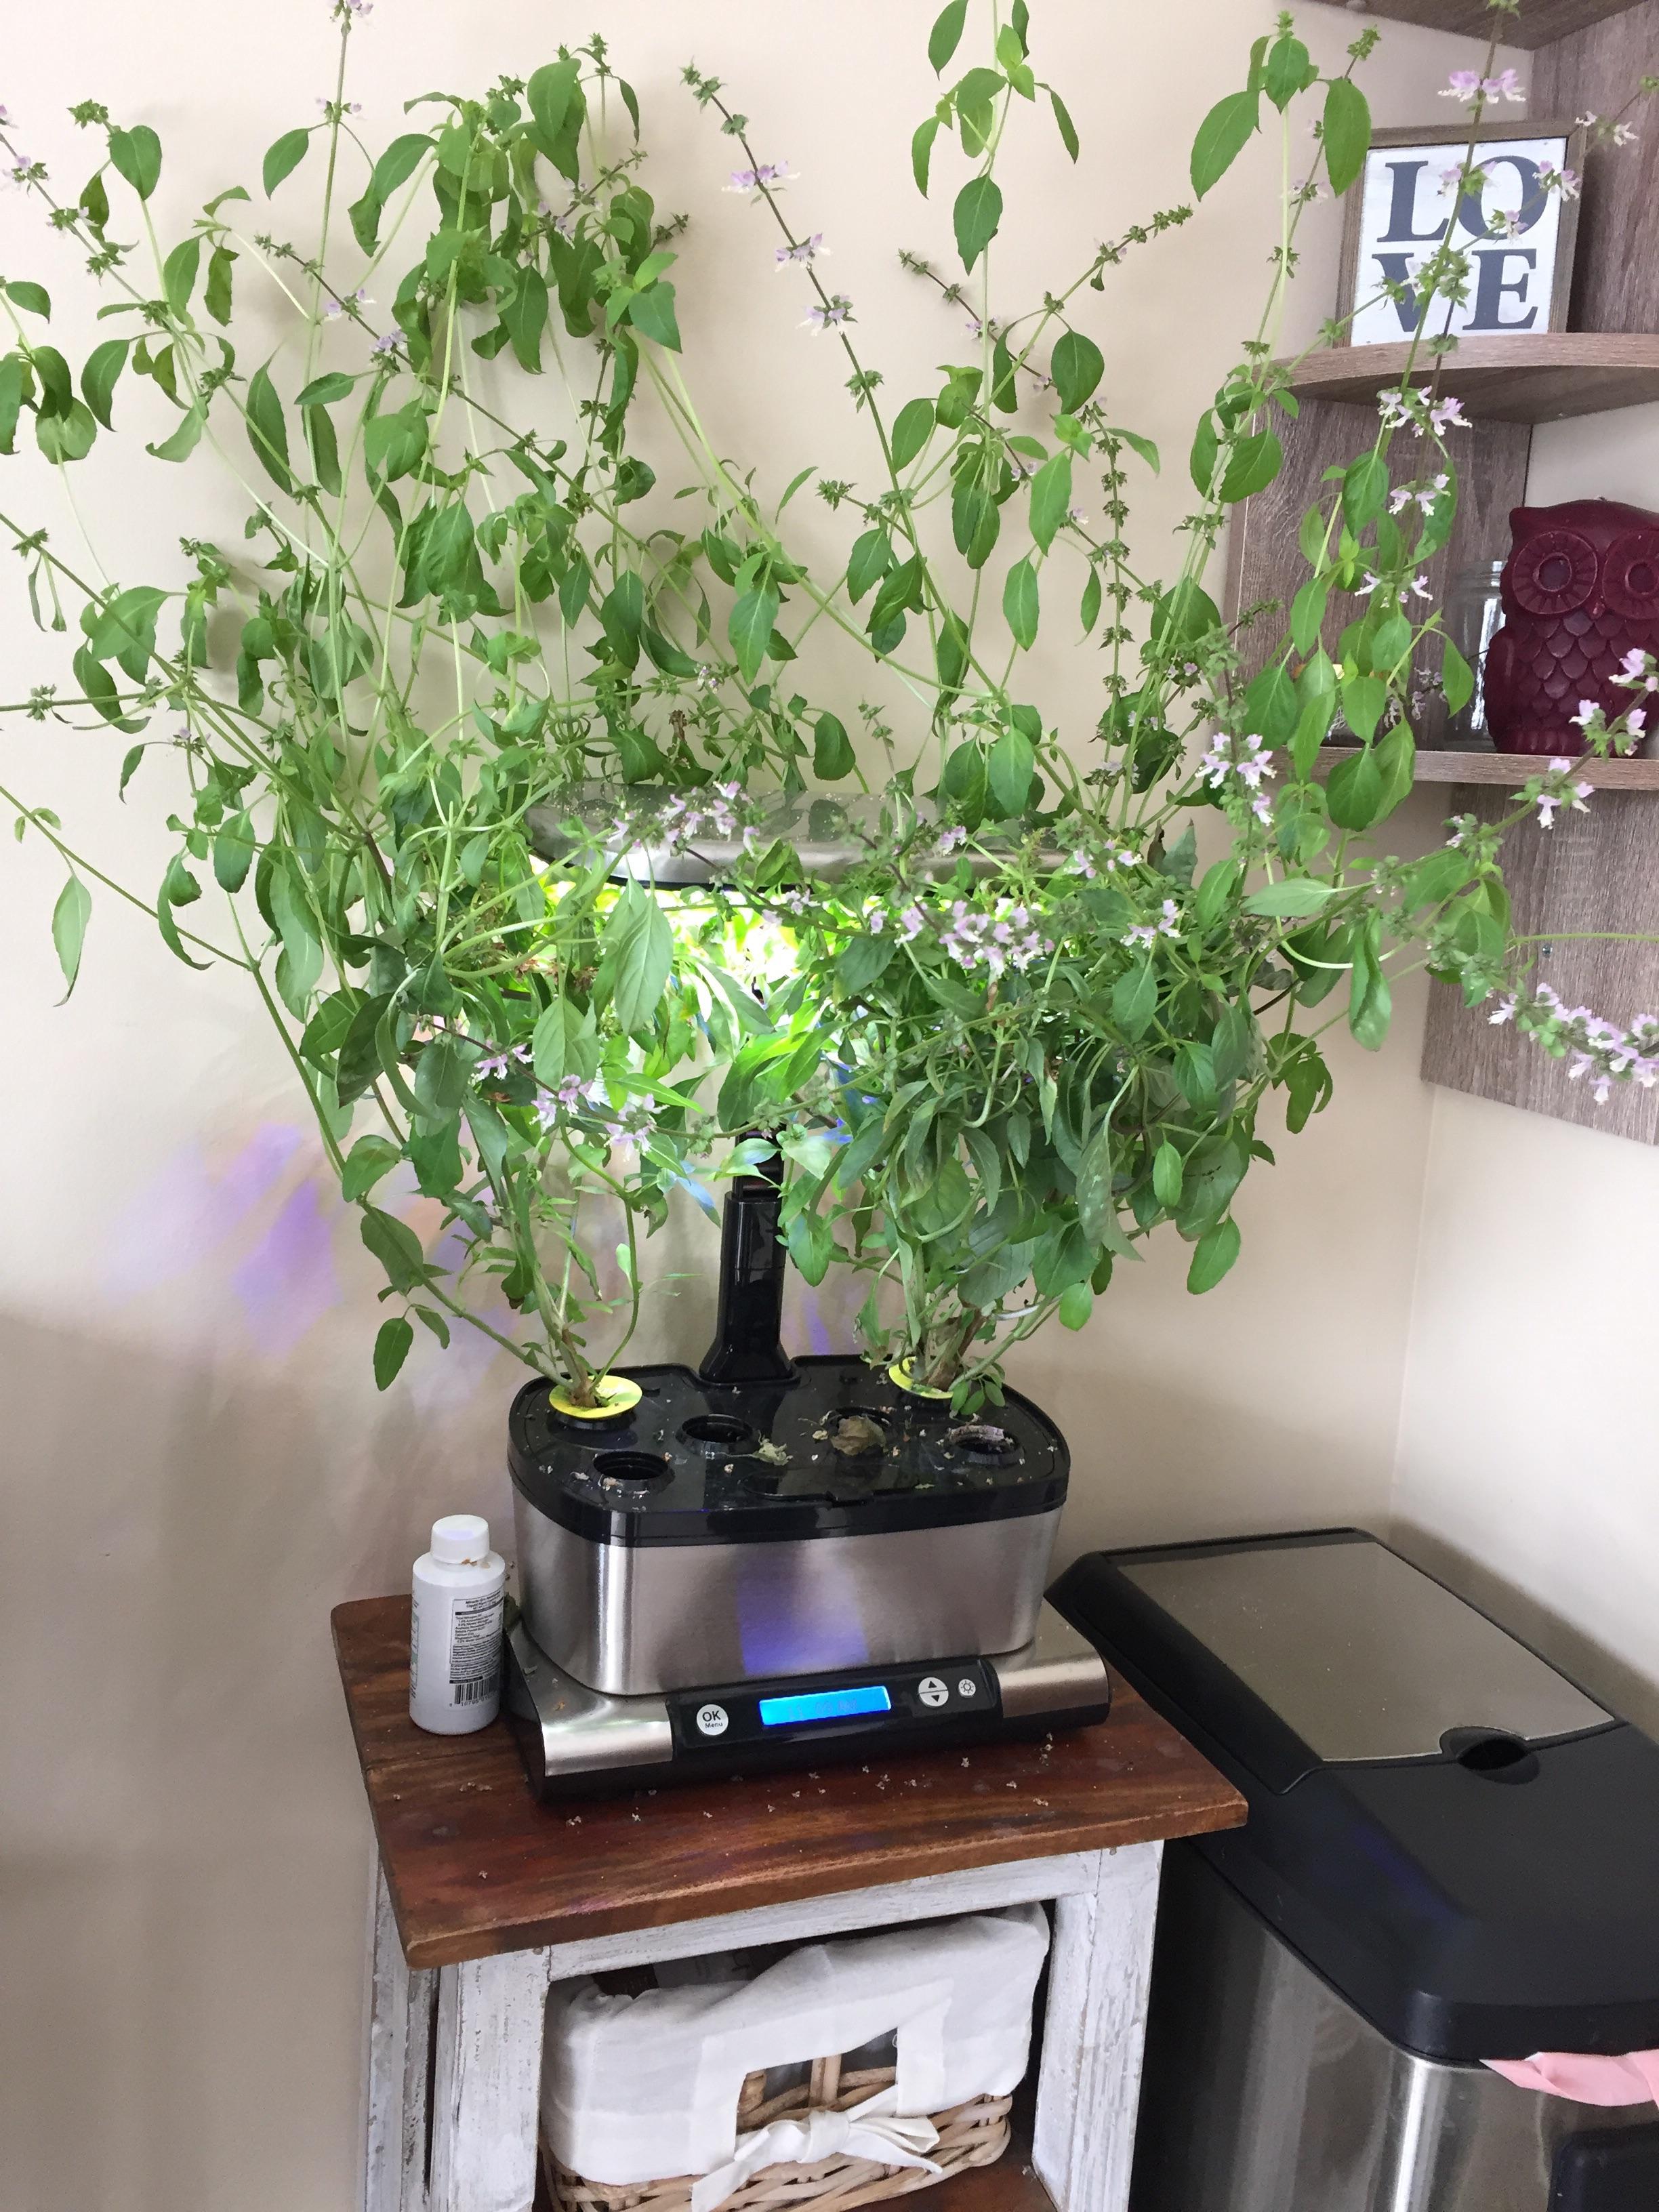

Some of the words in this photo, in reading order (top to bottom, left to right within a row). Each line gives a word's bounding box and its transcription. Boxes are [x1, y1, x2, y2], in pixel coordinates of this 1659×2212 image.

[1376, 155, 1549, 243] LO
[1371, 248, 1538, 333] VE
[702, 1710, 721, 1722] OK
